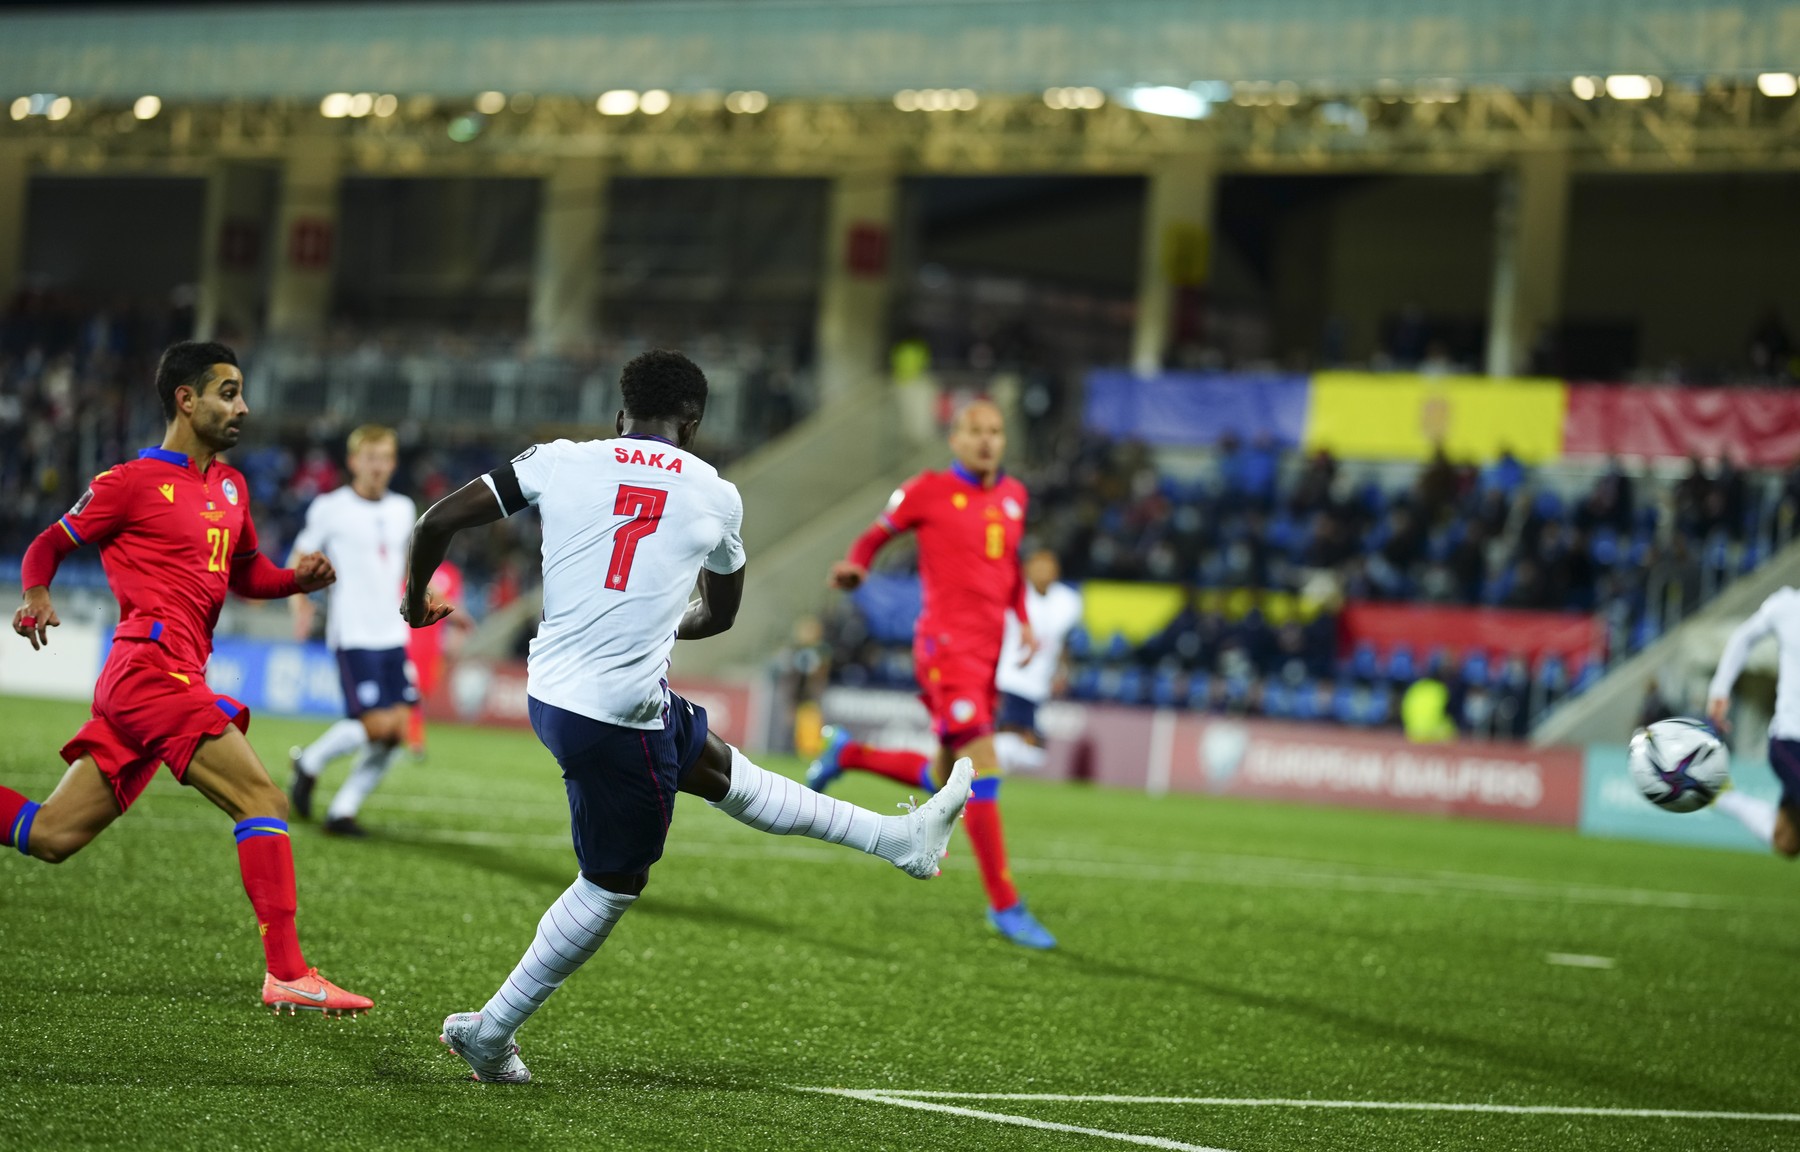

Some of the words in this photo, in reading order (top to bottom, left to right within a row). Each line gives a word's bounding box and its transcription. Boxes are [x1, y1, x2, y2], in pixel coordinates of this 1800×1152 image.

[614, 447, 683, 474] SAKA
[206, 527, 230, 572] 21
[604, 483, 668, 592] 7
